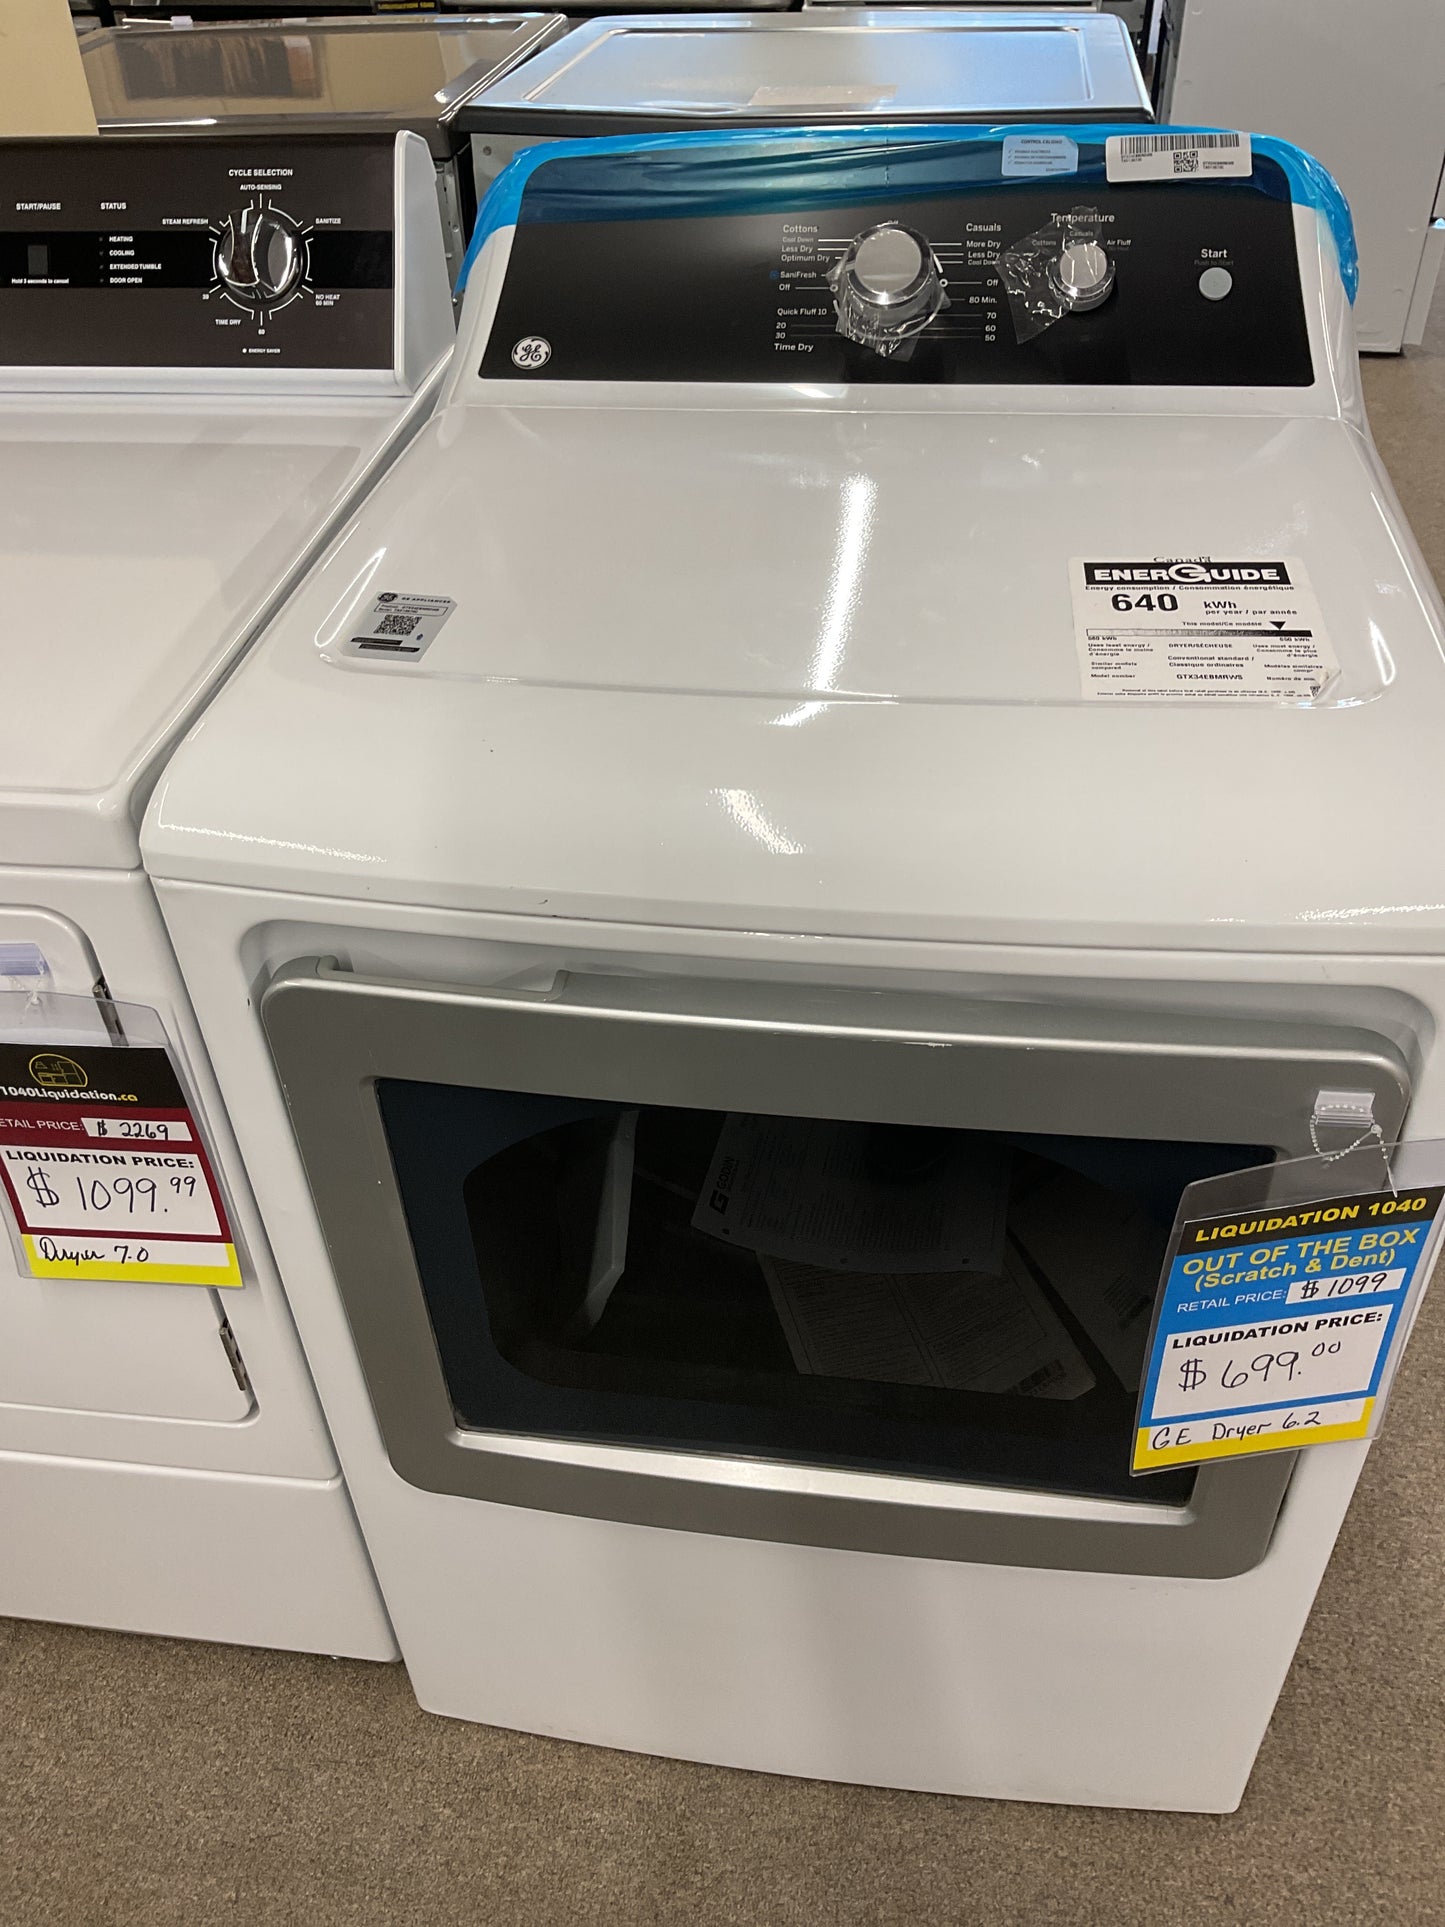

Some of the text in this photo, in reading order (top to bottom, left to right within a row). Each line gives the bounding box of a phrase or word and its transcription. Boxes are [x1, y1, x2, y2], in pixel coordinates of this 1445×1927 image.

[228, 169, 293, 177] CYCLE SELECTION
[16, 203, 61, 211] START/PAUSE
[1050, 213, 1115, 224] Temperature
[783, 224, 818, 233] Cottons
[965, 223, 1002, 232] Casuals
[966, 240, 1001, 249] More Dry
[781, 245, 813, 254] Less Dry
[1200, 248, 1228, 259] Start
[781, 254, 831, 263] Optimum Dry
[987, 251, 1000, 260] Dry
[780, 271, 817, 279] SaniFresh
[778, 283, 791, 291] Off
[986, 278, 999, 287] Off
[969, 296, 998, 304] 80 Min.
[777, 308, 799, 317] Quick
[986, 312, 997, 320] 70
[775, 322, 787, 330] 20
[984, 324, 996, 332] 60
[984, 334, 996, 342] 50
[774, 343, 814, 352] Time Dry
[1094, 563, 1280, 584] ENERGUIDE
[1112, 593, 1237, 612] 640 kWh
[0, 1085, 138, 1102] 1040Liquidation.ca
[0, 1118, 169, 1140] ETAIL PRICE: $ 2269
[7, 1150, 194, 1169] LIQUIDATION PRICE:
[26, 1166, 60, 1208] $
[1195, 1197, 1427, 1243] LIQUIDATION 1040
[113, 1245, 149, 1264] 7.0
[1183, 1228, 1421, 1276] OUT OF THE BOX
[1195, 1249, 1396, 1292] (Scratch & Dent)
[1177, 1272, 1387, 1313] RETAIL PRICE: $ 1099
[1172, 1311, 1383, 1349] LIQUIDATION PRICE:
[1178, 1358, 1207, 1392] $
[1212, 1419, 1272, 1441] Dryer
[1282, 1411, 1321, 1429] 6.2
